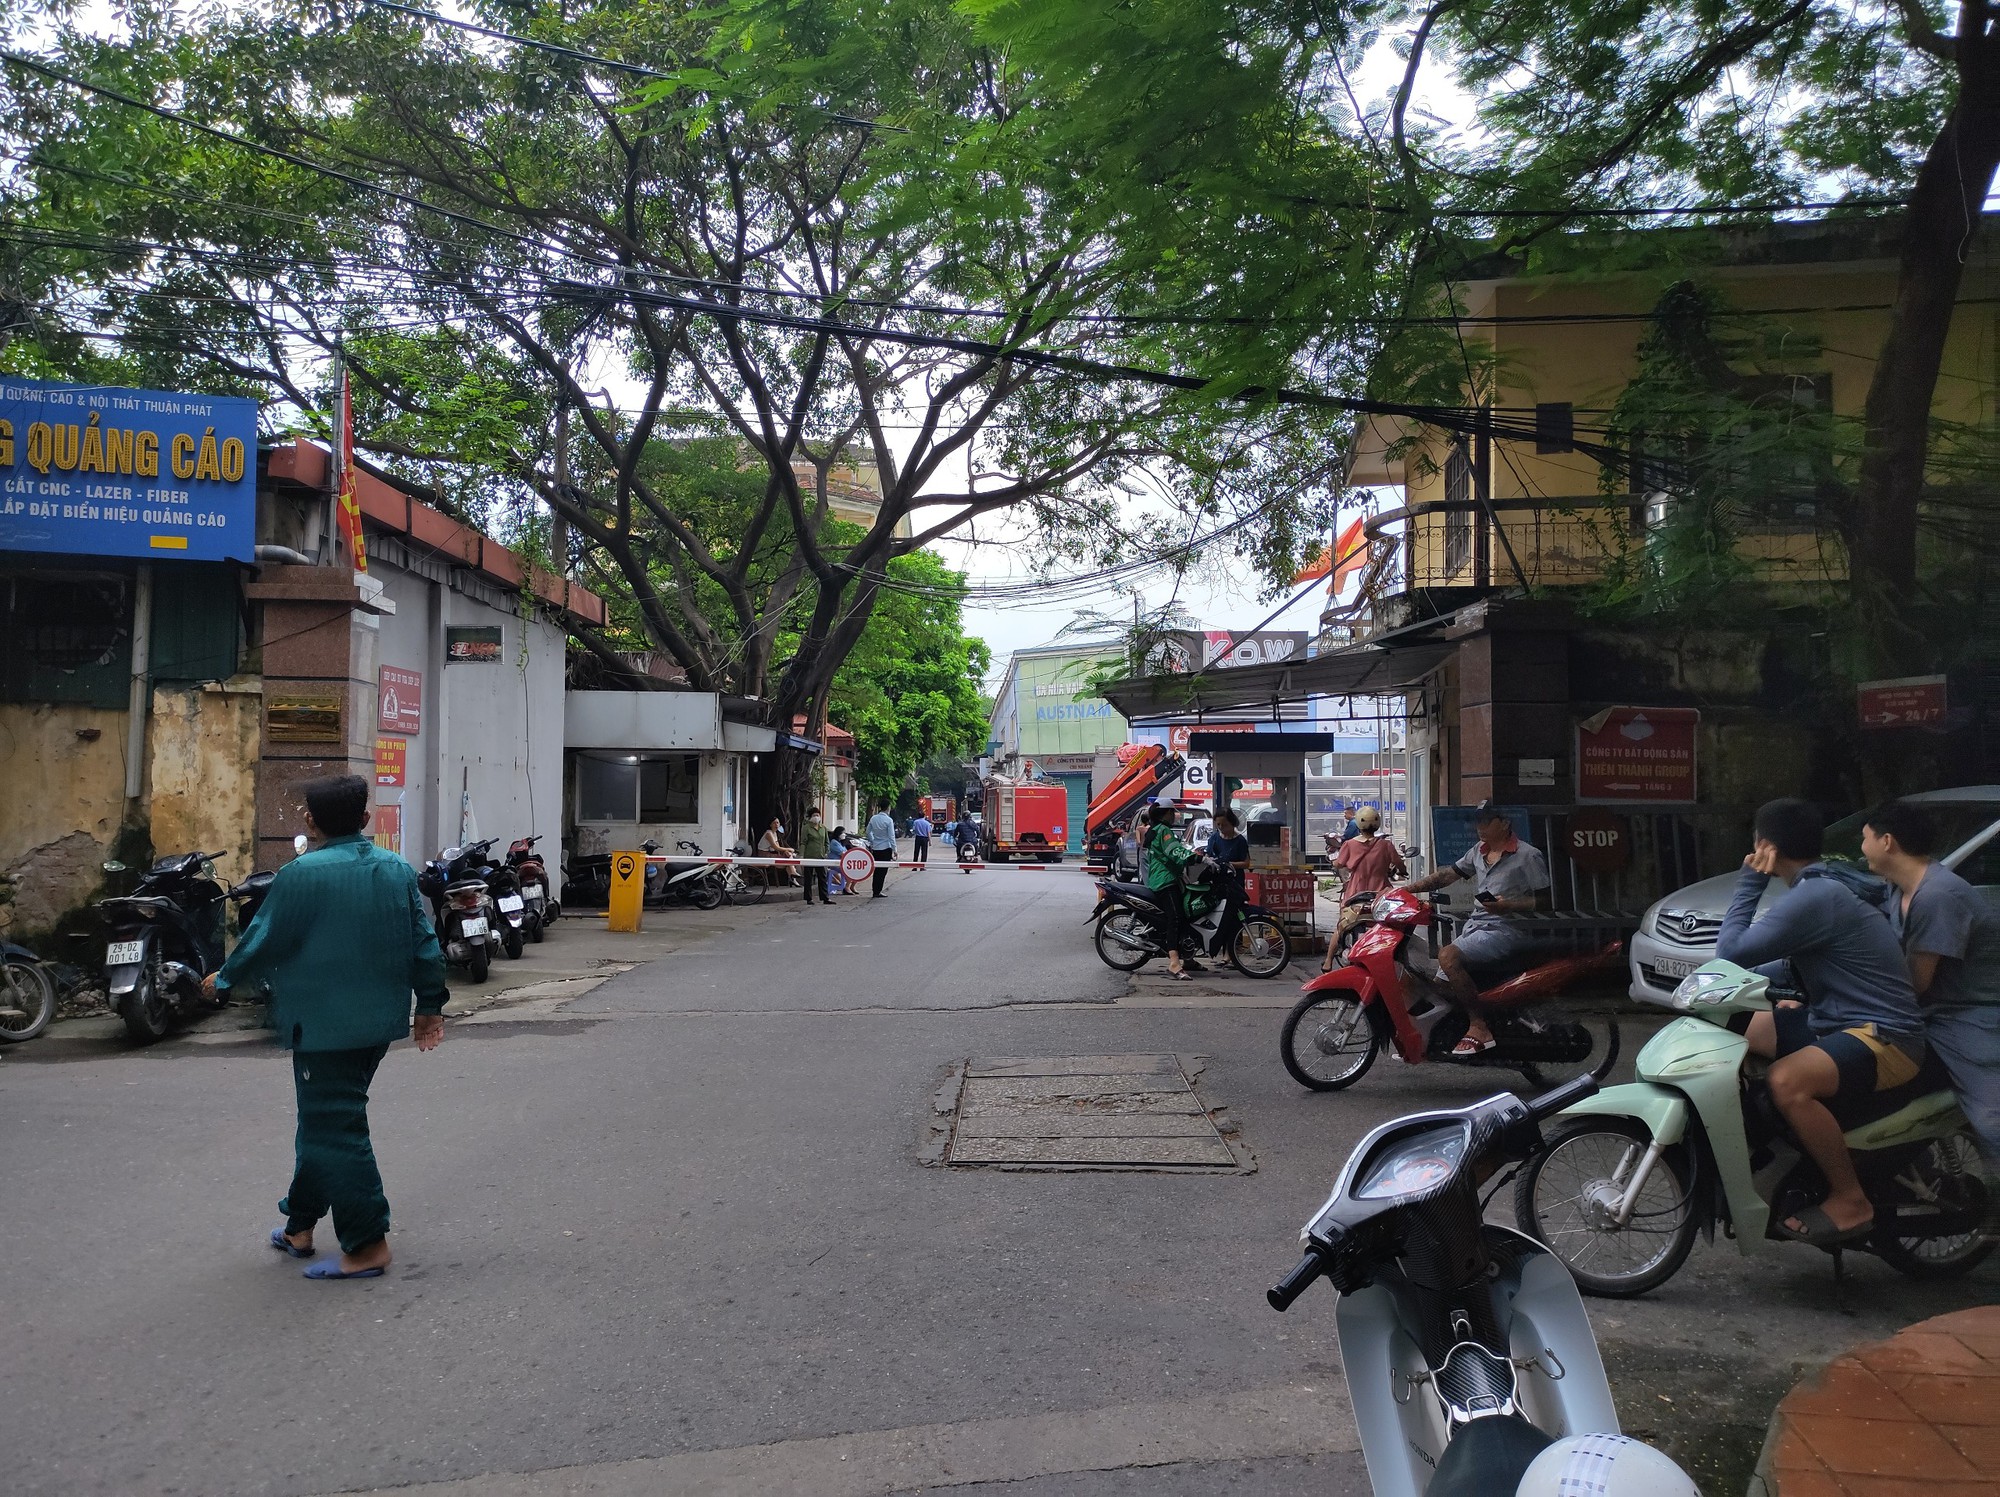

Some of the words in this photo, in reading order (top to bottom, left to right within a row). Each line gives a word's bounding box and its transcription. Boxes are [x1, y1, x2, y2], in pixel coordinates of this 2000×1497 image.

[89, 394, 109, 410] NỘI
[144, 400, 180, 416] THUẬN
[27, 410, 158, 477] QUẢNG
[171, 426, 244, 482] CÁO
[5, 475, 35, 494] CẮT
[39, 482, 71, 497] CNC
[86, 484, 132, 500] LAZER
[147, 489, 189, 504] FIBER
[29, 500, 60, 520] ĐẶT
[63, 500, 100, 519] BIỂN
[103, 505, 138, 524] HIỆU
[142, 507, 193, 526] QUẢNG
[197, 511, 226, 527] CÁO
[1038, 702, 1112, 720] AUSTNAM
[1586, 746, 1610, 758] CÔNG
[1612, 748, 1622, 758] TY
[1573, 830, 1618, 847] STOP
[846, 860, 867, 870] STOP
[1287, 877, 1308, 889] VÀO
[1266, 894, 1280, 904] XE
